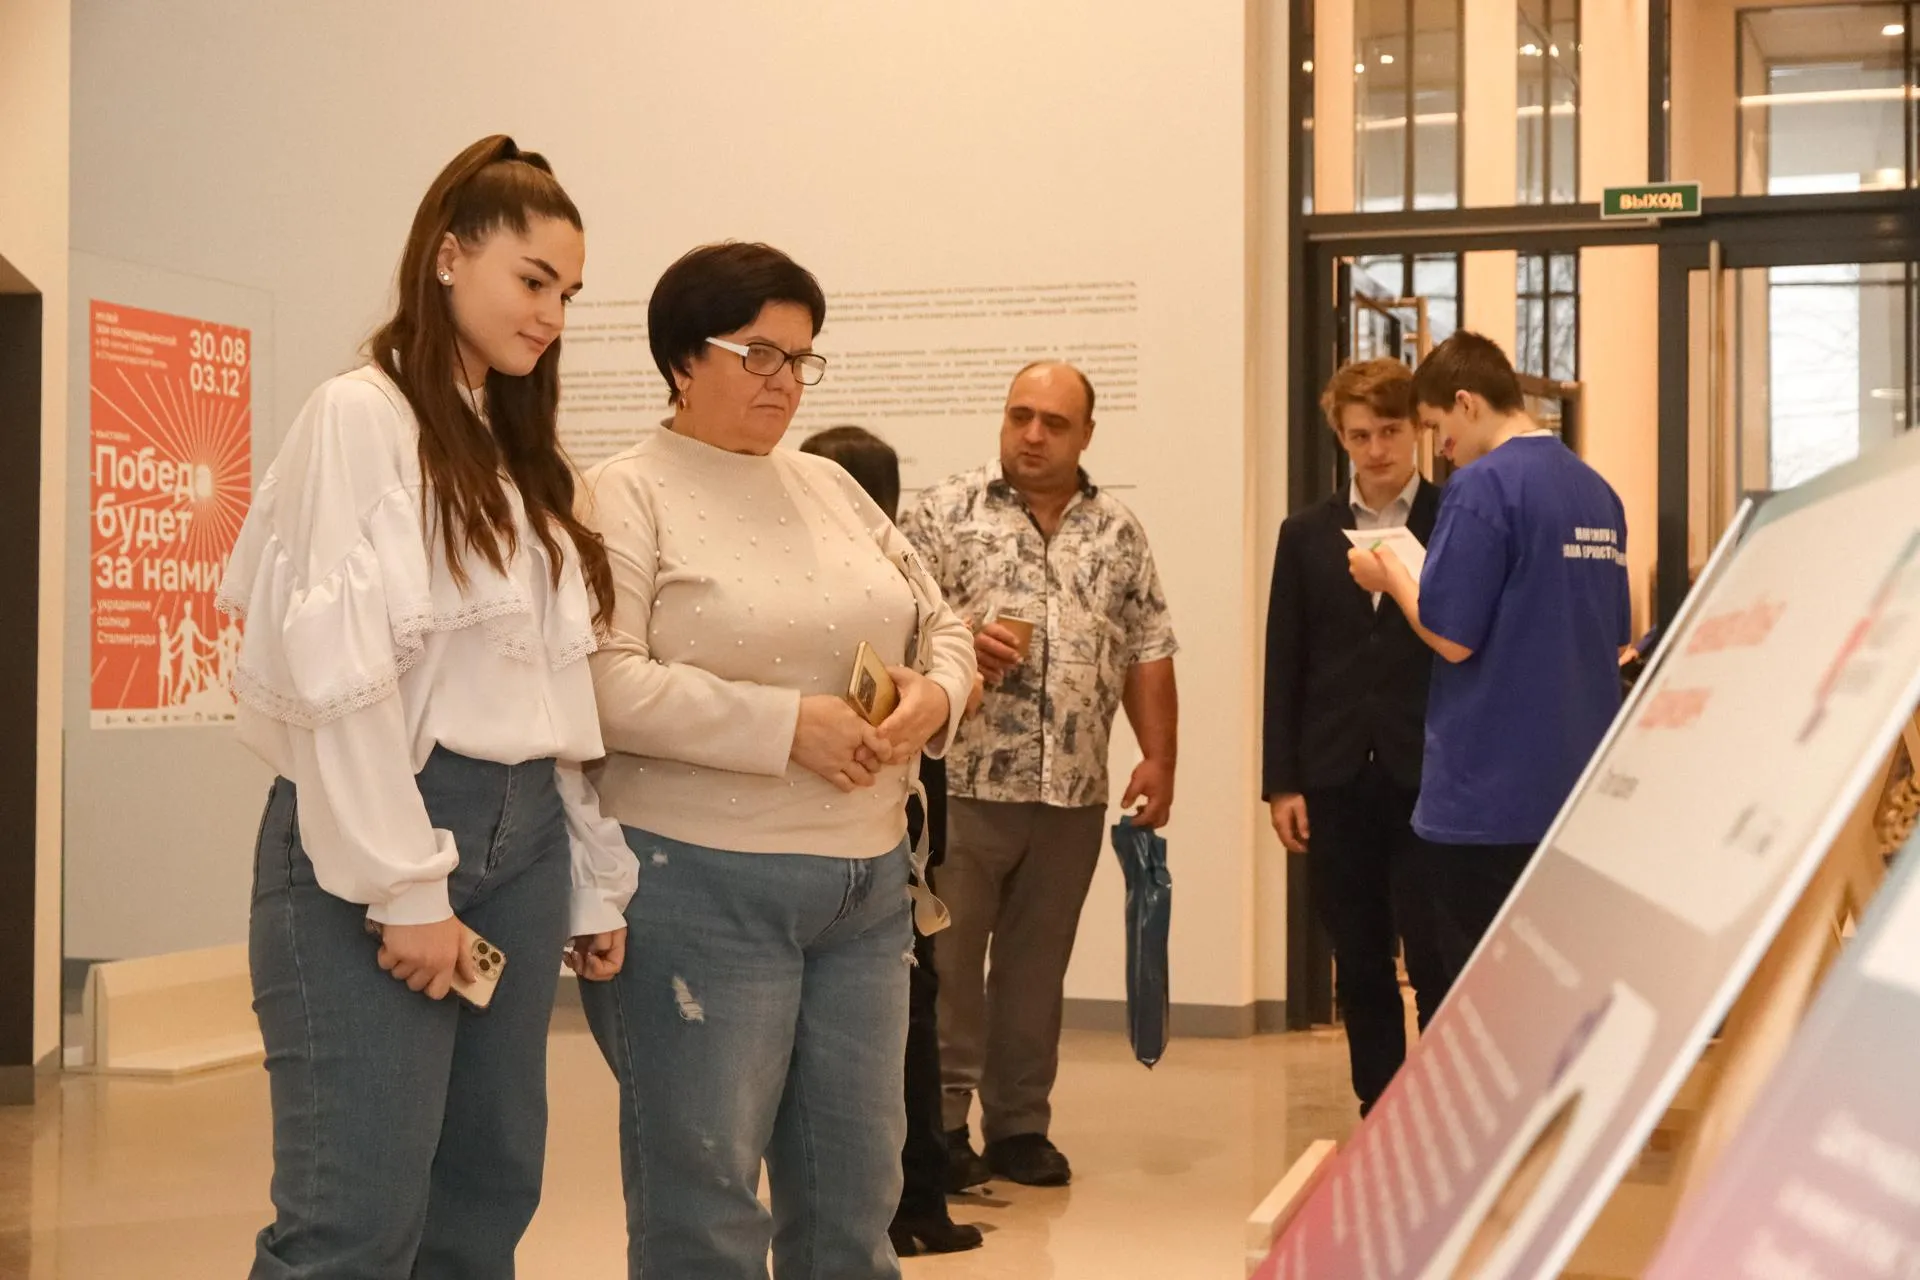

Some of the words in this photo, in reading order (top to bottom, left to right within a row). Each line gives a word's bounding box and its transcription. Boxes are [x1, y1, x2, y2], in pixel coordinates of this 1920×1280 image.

[1619, 192, 1684, 211] ВЫХОД
[189, 328, 246, 367] 30.08
[190, 362, 241, 398] 03.12
[96, 492, 193, 554] будет
[96, 554, 133, 590] за
